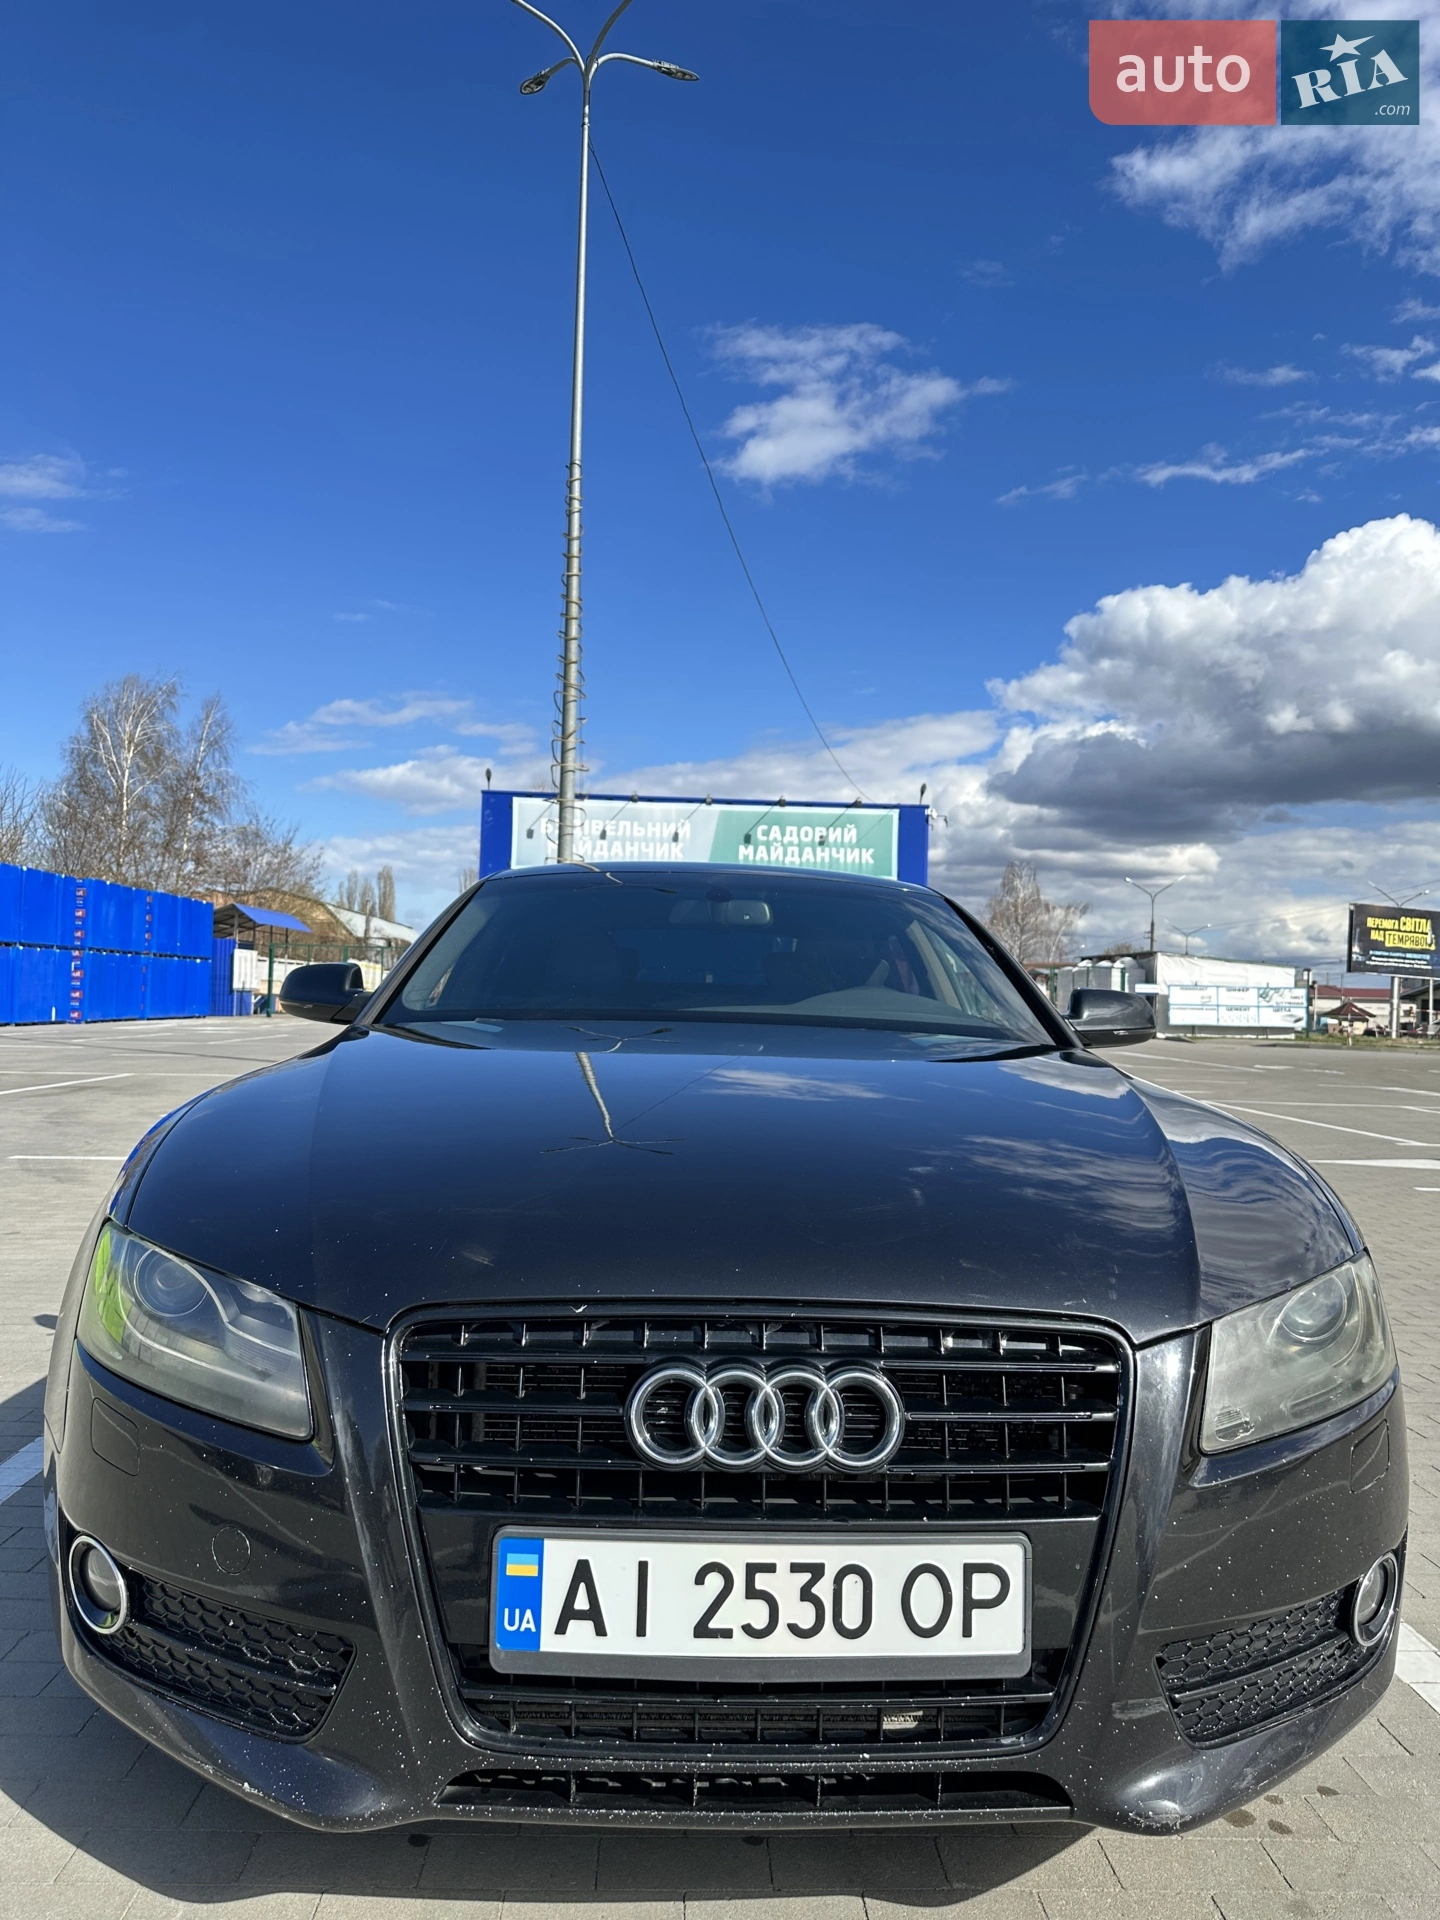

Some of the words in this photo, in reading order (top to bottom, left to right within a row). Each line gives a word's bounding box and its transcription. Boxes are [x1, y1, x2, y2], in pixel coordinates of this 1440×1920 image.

[756, 824, 858, 844] САДОВИЙ
[738, 842, 875, 865] МАЙДАНЧИК
[1366, 917, 1399, 930] ПЕРЕМОГА
[1400, 916, 1432, 933] СВІТЛА
[1370, 929, 1384, 942] НАД
[554, 1558, 648, 1638] AI
[693, 1560, 873, 1640] 2530
[900, 1561, 1011, 1639] OP
[504, 1608, 537, 1633] UA
